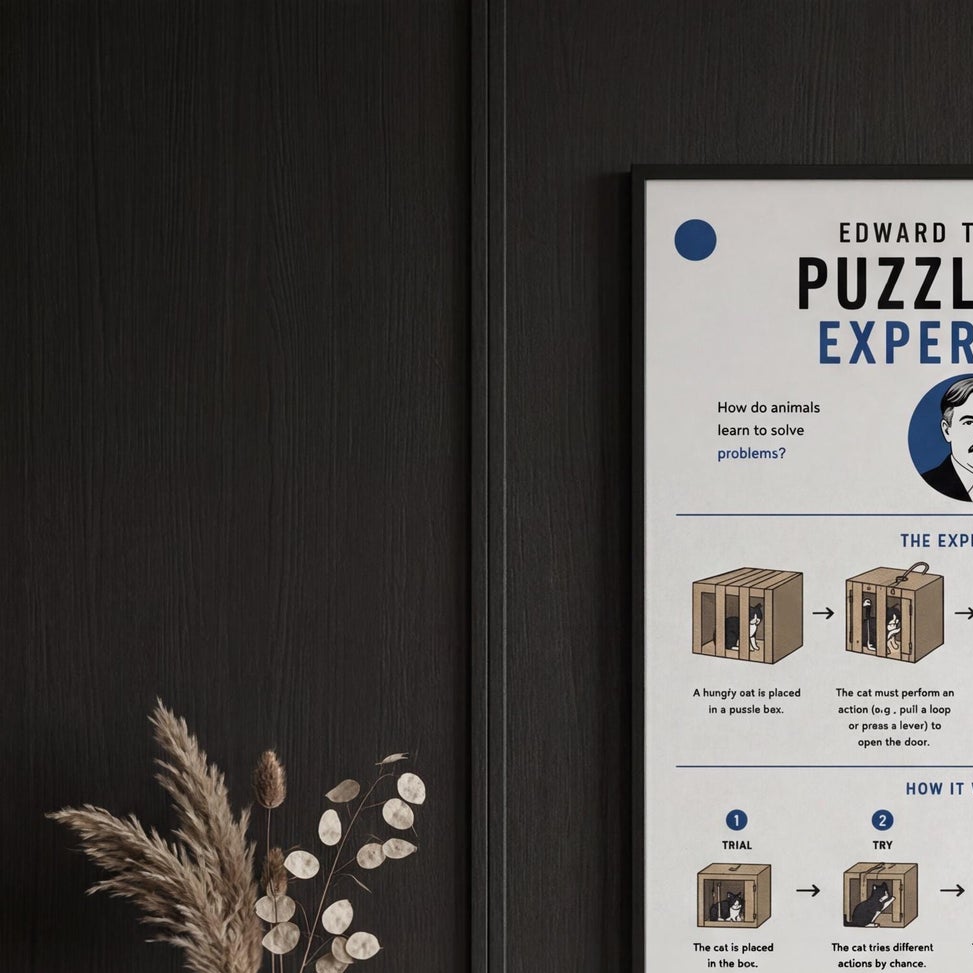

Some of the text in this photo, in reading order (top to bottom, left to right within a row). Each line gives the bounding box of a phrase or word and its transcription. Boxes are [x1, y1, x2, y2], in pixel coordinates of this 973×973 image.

[839, 222, 946, 244] EDWARD
[717, 400, 821, 414] How do animals
[717, 423, 805, 436] learn to solve
[717, 446, 787, 463] problems?
[900, 533, 931, 548] THE
[692, 688, 701, 697] A
[757, 688, 766, 698] is
[768, 687, 801, 700] placed
[835, 687, 854, 698] The
[856, 688, 872, 698] cat
[874, 688, 899, 698] must
[942, 690, 955, 698] an
[708, 704, 718, 714] in
[720, 706, 727, 714] a
[837, 704, 869, 714] action
[920, 706, 927, 714] a
[929, 704, 952, 717] loop
[930, 721, 942, 730] to
[857, 736, 930, 749] open the door.
[906, 781, 943, 796] HOW
[950, 782, 965, 796] IT
[733, 814, 739, 827] 1
[878, 814, 887, 827] 2
[721, 840, 753, 850] TRIAL
[872, 840, 893, 850] TRY
[692, 942, 774, 955] The cat is placed
[831, 942, 934, 953] The cat tries different
[707, 958, 717, 968] in
[718, 958, 735, 968] the
[874, 958, 887, 971] by
[889, 958, 927, 968] chance.
